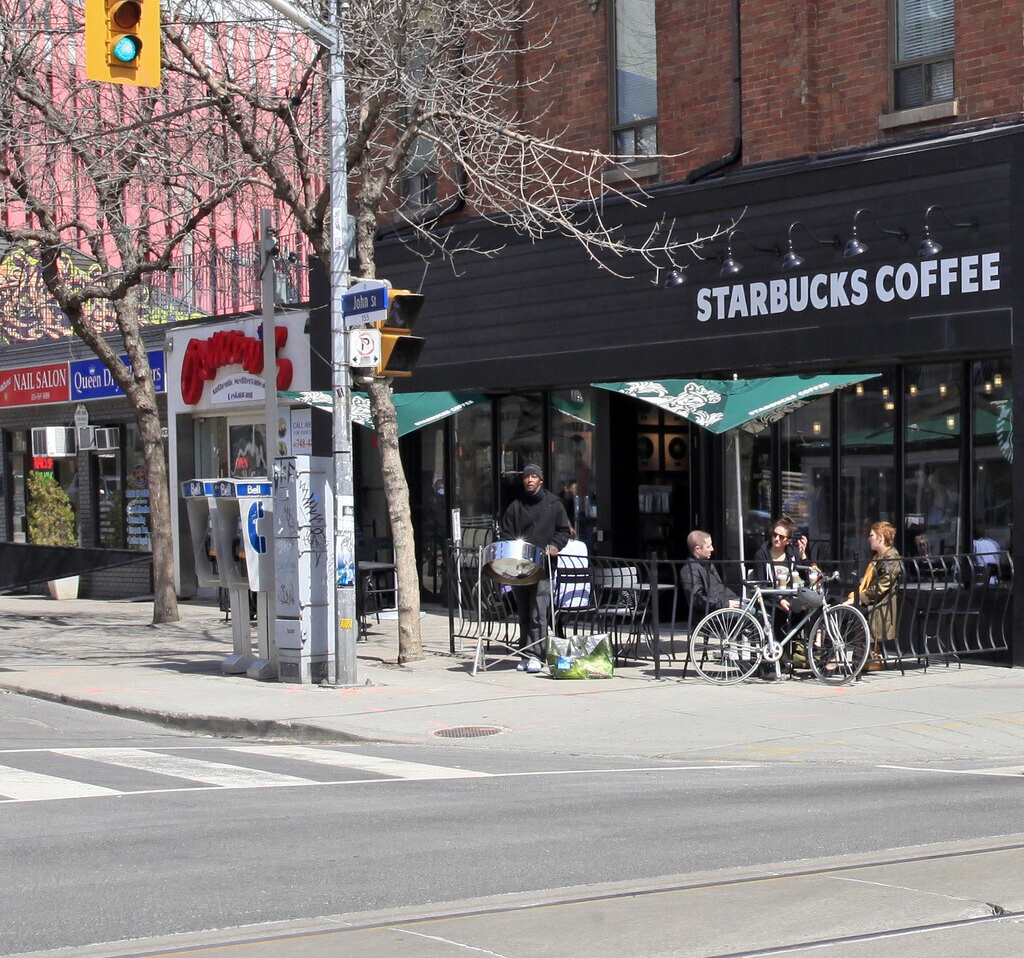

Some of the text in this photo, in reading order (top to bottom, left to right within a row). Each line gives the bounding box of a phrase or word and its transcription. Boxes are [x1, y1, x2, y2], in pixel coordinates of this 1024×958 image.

[696, 252, 1000, 322] STARBUCKS COFFEE
[353, 294, 377, 310] John St
[361, 314, 370, 322] 155
[13, 372, 35, 391] NAIL
[36, 368, 67, 388] SALON
[74, 371, 102, 393] Queen
[190, 483, 201, 496] Bell
[220, 483, 231, 496] Bell
[247, 485, 261, 495] Bell
